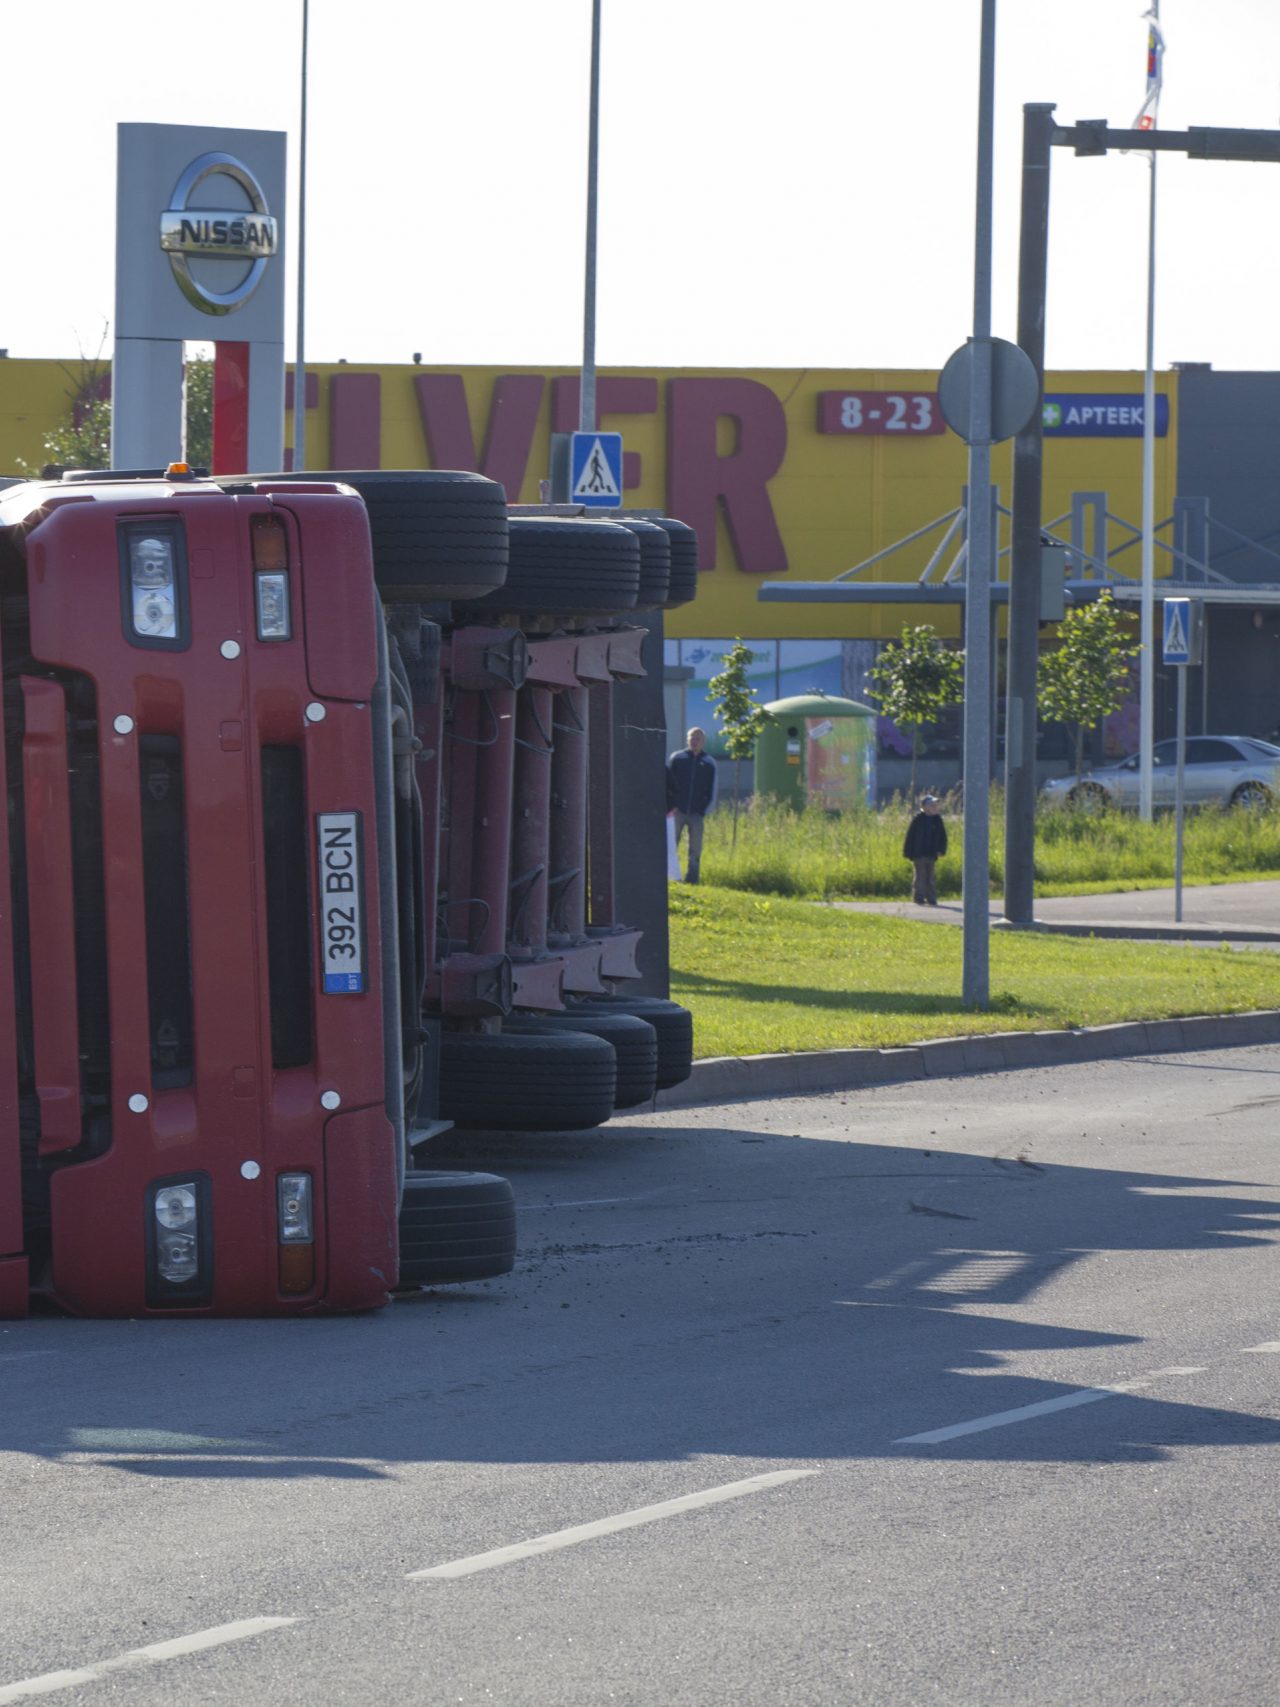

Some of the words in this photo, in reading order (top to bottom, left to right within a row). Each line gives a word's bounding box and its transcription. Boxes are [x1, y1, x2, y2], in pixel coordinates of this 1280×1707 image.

[179, 218, 274, 249] NISSAN
[1065, 406, 1145, 425] APTEEK
[324, 826, 354, 894] BCN
[327, 906, 356, 960] 392
[348, 974, 358, 990] EST
